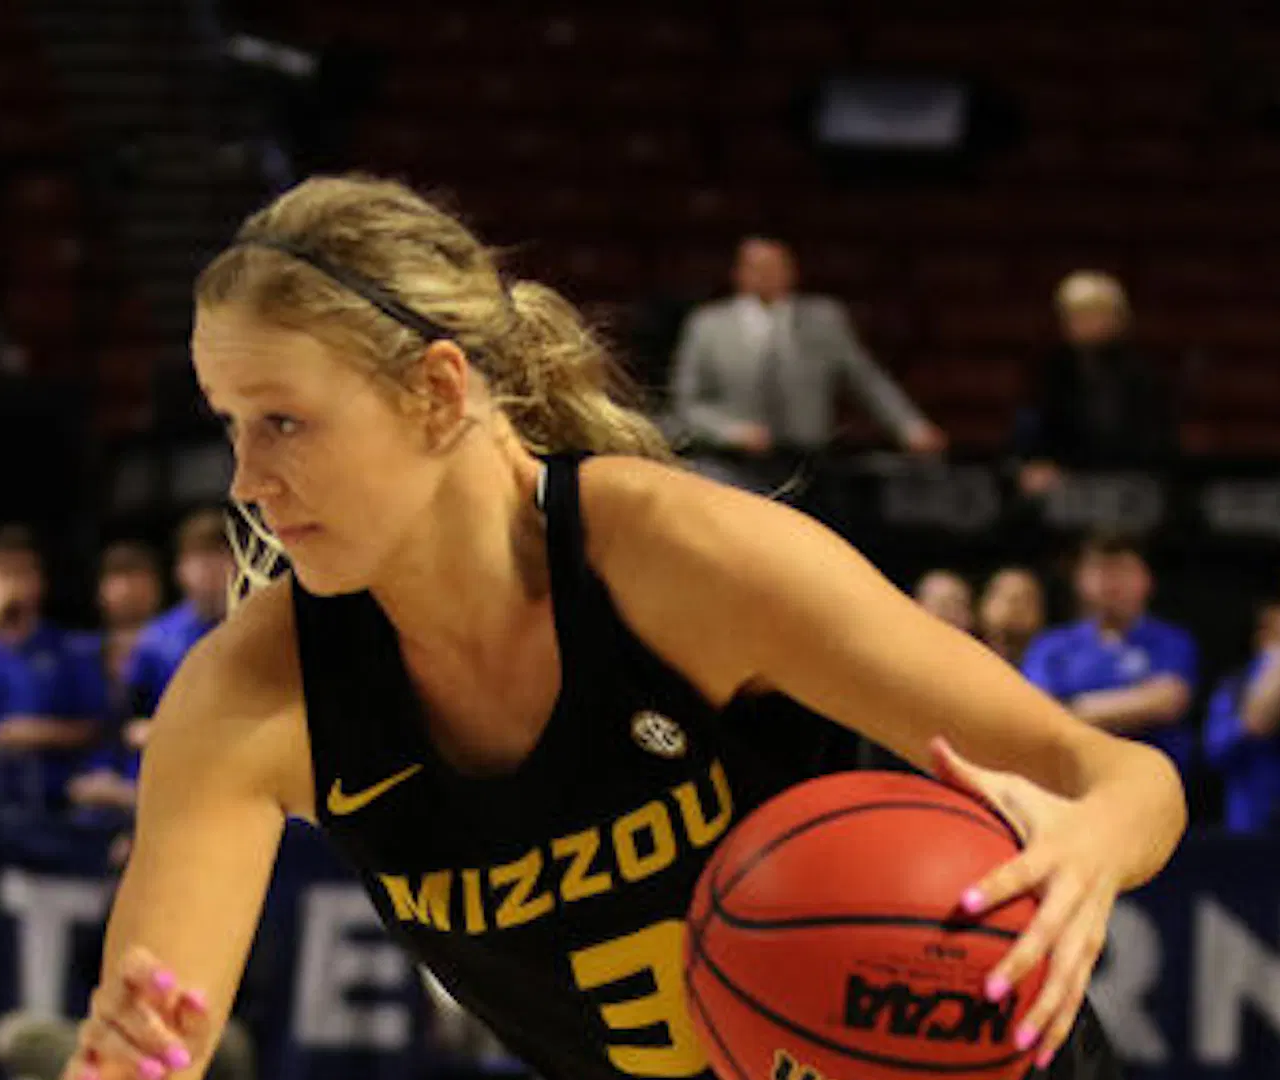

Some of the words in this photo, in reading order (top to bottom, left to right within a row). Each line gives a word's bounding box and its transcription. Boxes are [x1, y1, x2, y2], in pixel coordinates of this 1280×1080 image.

[377, 757, 733, 936] MIZZOU
[570, 918, 711, 1078] 3
[843, 971, 1018, 1046] NCAA
